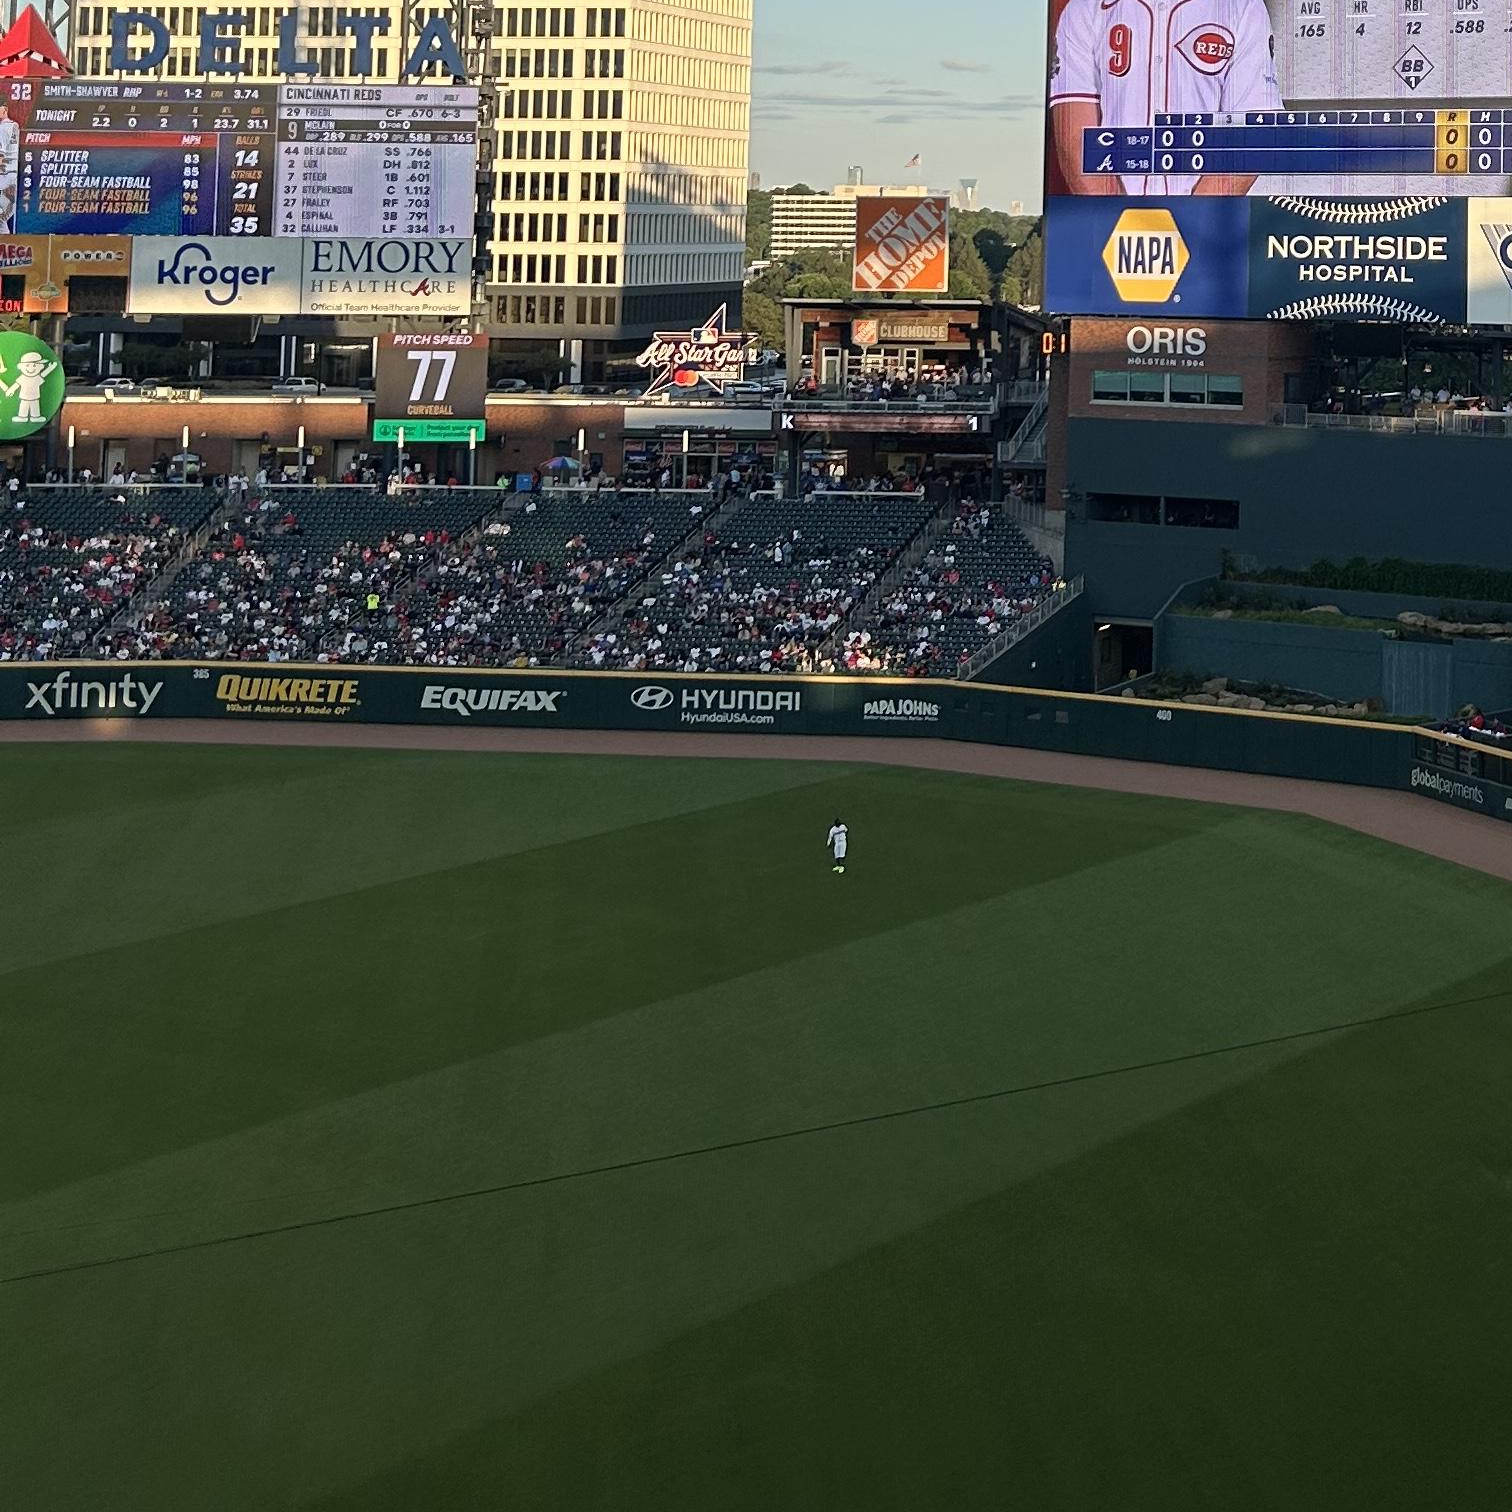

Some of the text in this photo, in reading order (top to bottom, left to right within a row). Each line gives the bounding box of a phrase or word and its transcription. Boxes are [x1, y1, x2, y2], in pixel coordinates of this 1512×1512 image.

[1301, 1, 1321, 15] AVG
[1354, 0, 1369, 13] HR
[1405, 0, 1423, 12] RBI
[1295, 24, 1326, 37] .165
[1406, 22, 1422, 35] 12
[1449, 20, 1485, 34] .588
[111, 11, 468, 77] DELTA
[1195, 41, 1235, 59] REDS
[1401, 59, 1424, 73] BB
[11, 83, 32, 100] 32
[233, 89, 259, 99] 3.74
[286, 88, 382, 101] CINCINNATI REDS
[36, 110, 239, 129] TONIGHT 2.2 23.7
[407, 108, 434, 118] .670
[25, 133, 51, 143] PITCH
[40, 150, 200, 164] SPLITTER 83
[234, 150, 259, 167] 14
[406, 147, 432, 157] .766
[40, 163, 89, 176] SPLITTER
[1125, 159, 1149, 170] 15-18
[39, 176, 199, 189] FOUR-SEAM FASTBALL 98
[232, 182, 259, 199] 21
[229, 217, 258, 234] 35
[865, 207, 902, 243] THE
[855, 198, 946, 288] HOME
[1266, 235, 1448, 261] NORTHSIDE
[311, 240, 464, 273] EMORY
[889, 231, 946, 289] DEPOT
[1116, 236, 1175, 275] NAPA
[157, 242, 275, 305] Kroger
[1299, 265, 1414, 283] HOSPITAL
[311, 277, 456, 296] HEALTHCARE
[311, 302, 461, 312] Official Team Healthcare Provider
[880, 324, 946, 338] CLUBHOUSE
[393, 335, 473, 345] PITCH SPEED
[1126, 326, 1207, 356] ORIS
[636, 340, 714, 367] All Star
[1181, 359, 1205, 367] 1904
[407, 350, 457, 401] 77
[407, 404, 454, 416] CURVEBALL
[25, 671, 163, 715] xfinity
[216, 674, 359, 704] QUIKRETE
[420, 685, 562, 716] EQUIFAX
[681, 689, 801, 711] HYUNDAI
[863, 699, 939, 716] PAPA JOHNS
[226, 703, 252, 713] What
[255, 705, 302, 714] America's
[305, 706, 332, 715] Made
[680, 711, 774, 724] HyundaiUSA.com
[1156, 710, 1172, 721] 400
[1411, 766, 1484, 804] globalpayments
